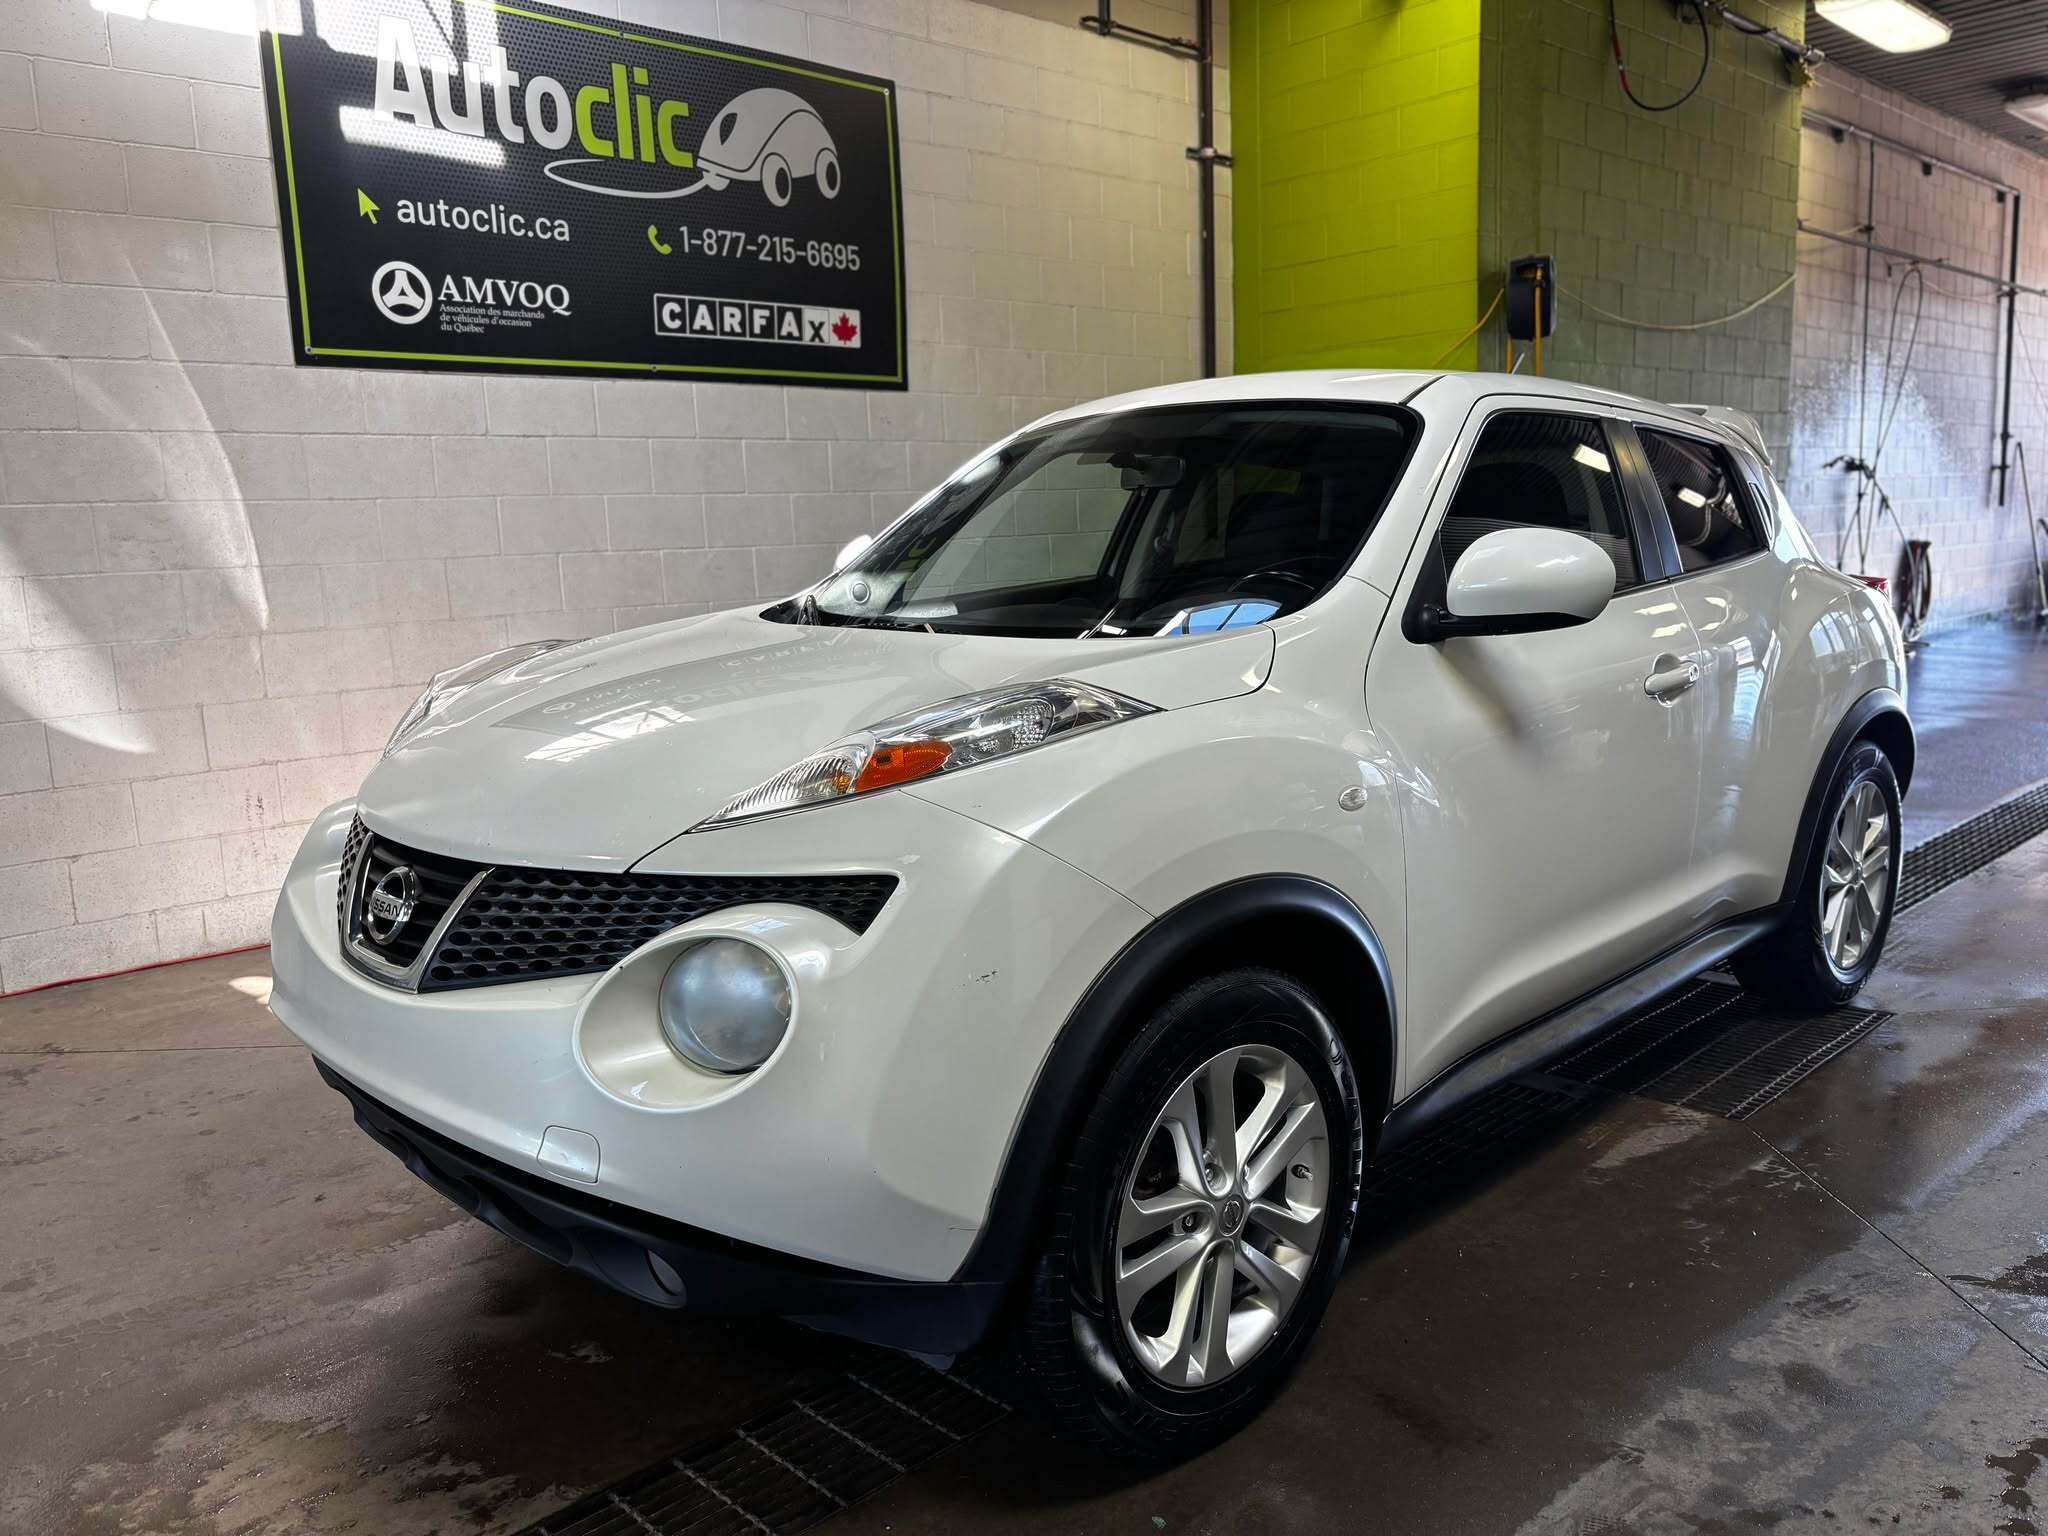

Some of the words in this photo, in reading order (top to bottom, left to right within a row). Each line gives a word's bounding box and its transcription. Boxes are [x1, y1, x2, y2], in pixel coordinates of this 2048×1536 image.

[374, 14, 694, 169] Autoclic
[396, 199, 570, 242] autoclic.ca
[679, 225, 861, 271] 1-877-215-6695
[438, 274, 572, 316] AMVOQ
[439, 303, 486, 315] Association
[487, 308, 501, 317] des
[503, 309, 545, 319] marchands
[440, 313, 451, 322] de
[452, 313, 490, 325] véhicules
[491, 316, 532, 327] d'occasion
[441, 323, 453, 331] du
[454, 323, 485, 334] Québec
[661, 302, 826, 343] CARFAX
